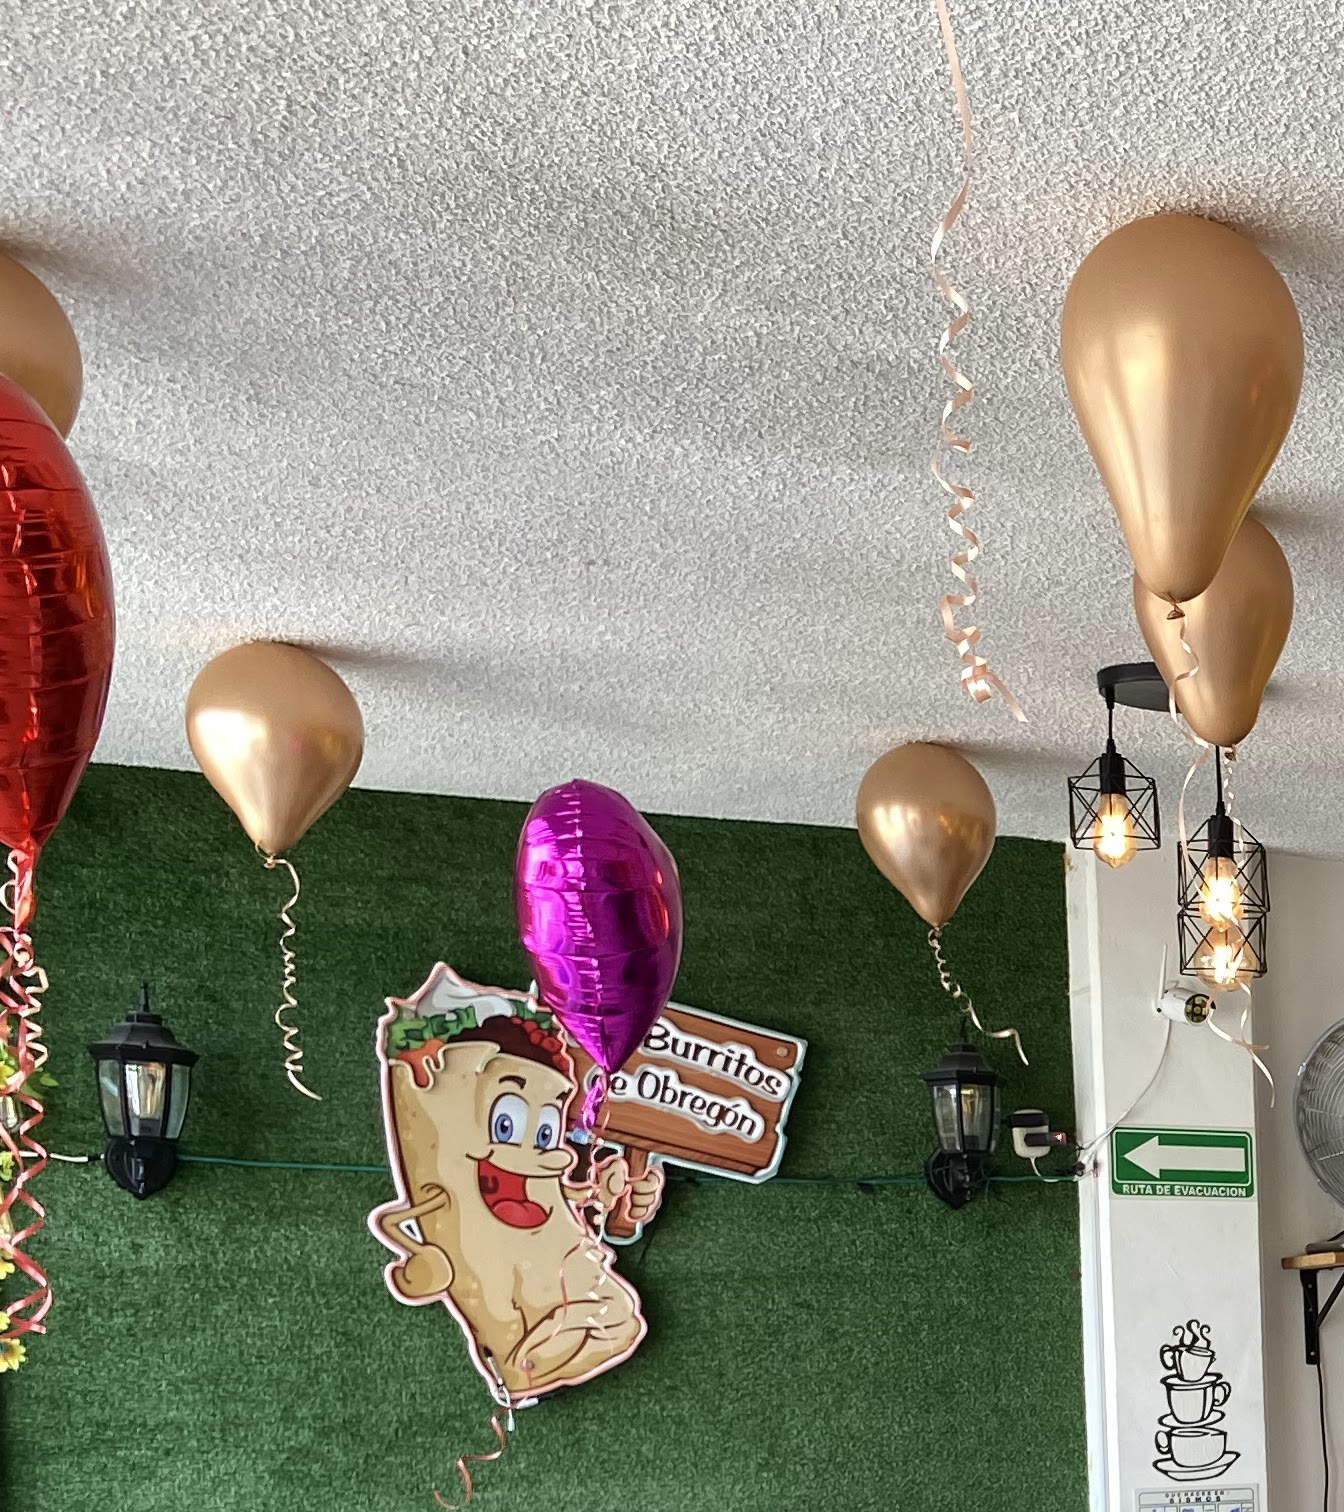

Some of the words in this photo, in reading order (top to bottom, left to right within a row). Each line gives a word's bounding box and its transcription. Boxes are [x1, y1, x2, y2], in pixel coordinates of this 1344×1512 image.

[643, 1023, 782, 1096] Burritos
[637, 1071, 757, 1136] Obregón
[1122, 1184, 1152, 1195] RUTA
[1156, 1185, 1171, 1195] DE
[1174, 1185, 1246, 1197] EVACUACION
